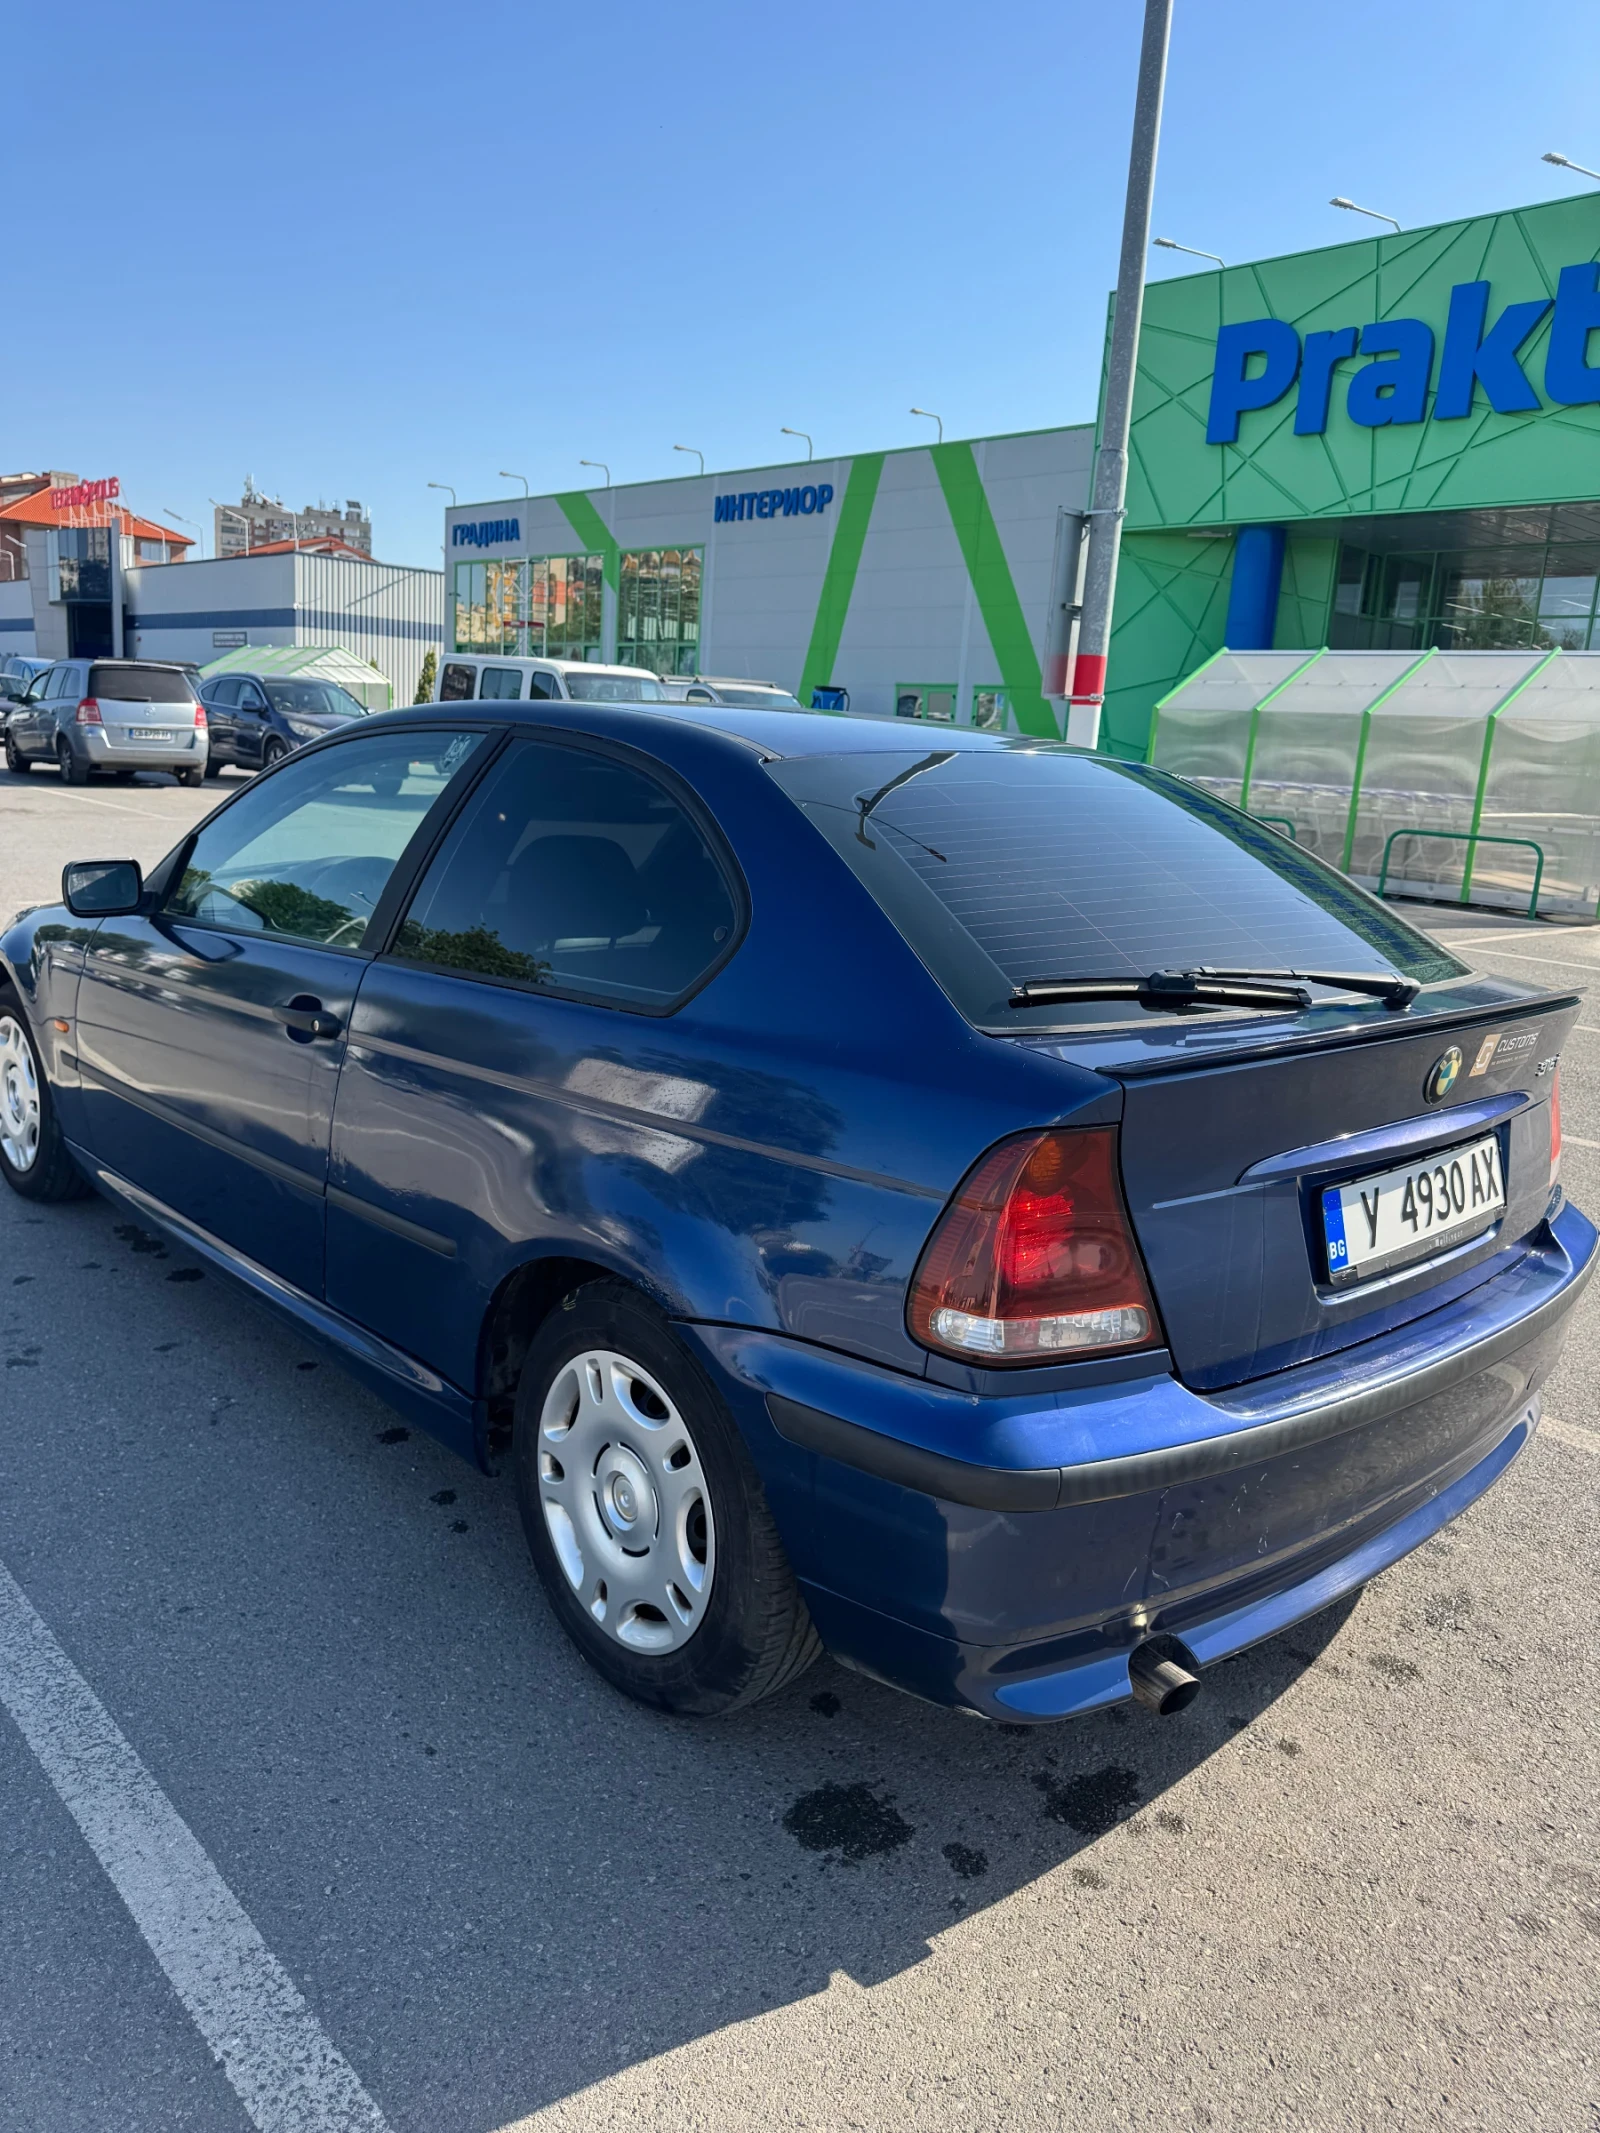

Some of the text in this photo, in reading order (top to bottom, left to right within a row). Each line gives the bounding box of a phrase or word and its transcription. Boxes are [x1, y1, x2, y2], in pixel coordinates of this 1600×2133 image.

[1206, 262, 1600, 445] Prakt
[714, 484, 833, 523] ИНТЕРИОР
[452, 518, 520, 548] ГРАДИНА
[1497, 1032, 1540, 1053] CUSTOMS
[1401, 1159, 1466, 1234] 4930
[1470, 1146, 1500, 1209] AX
[1328, 1239, 1346, 1260] BG
